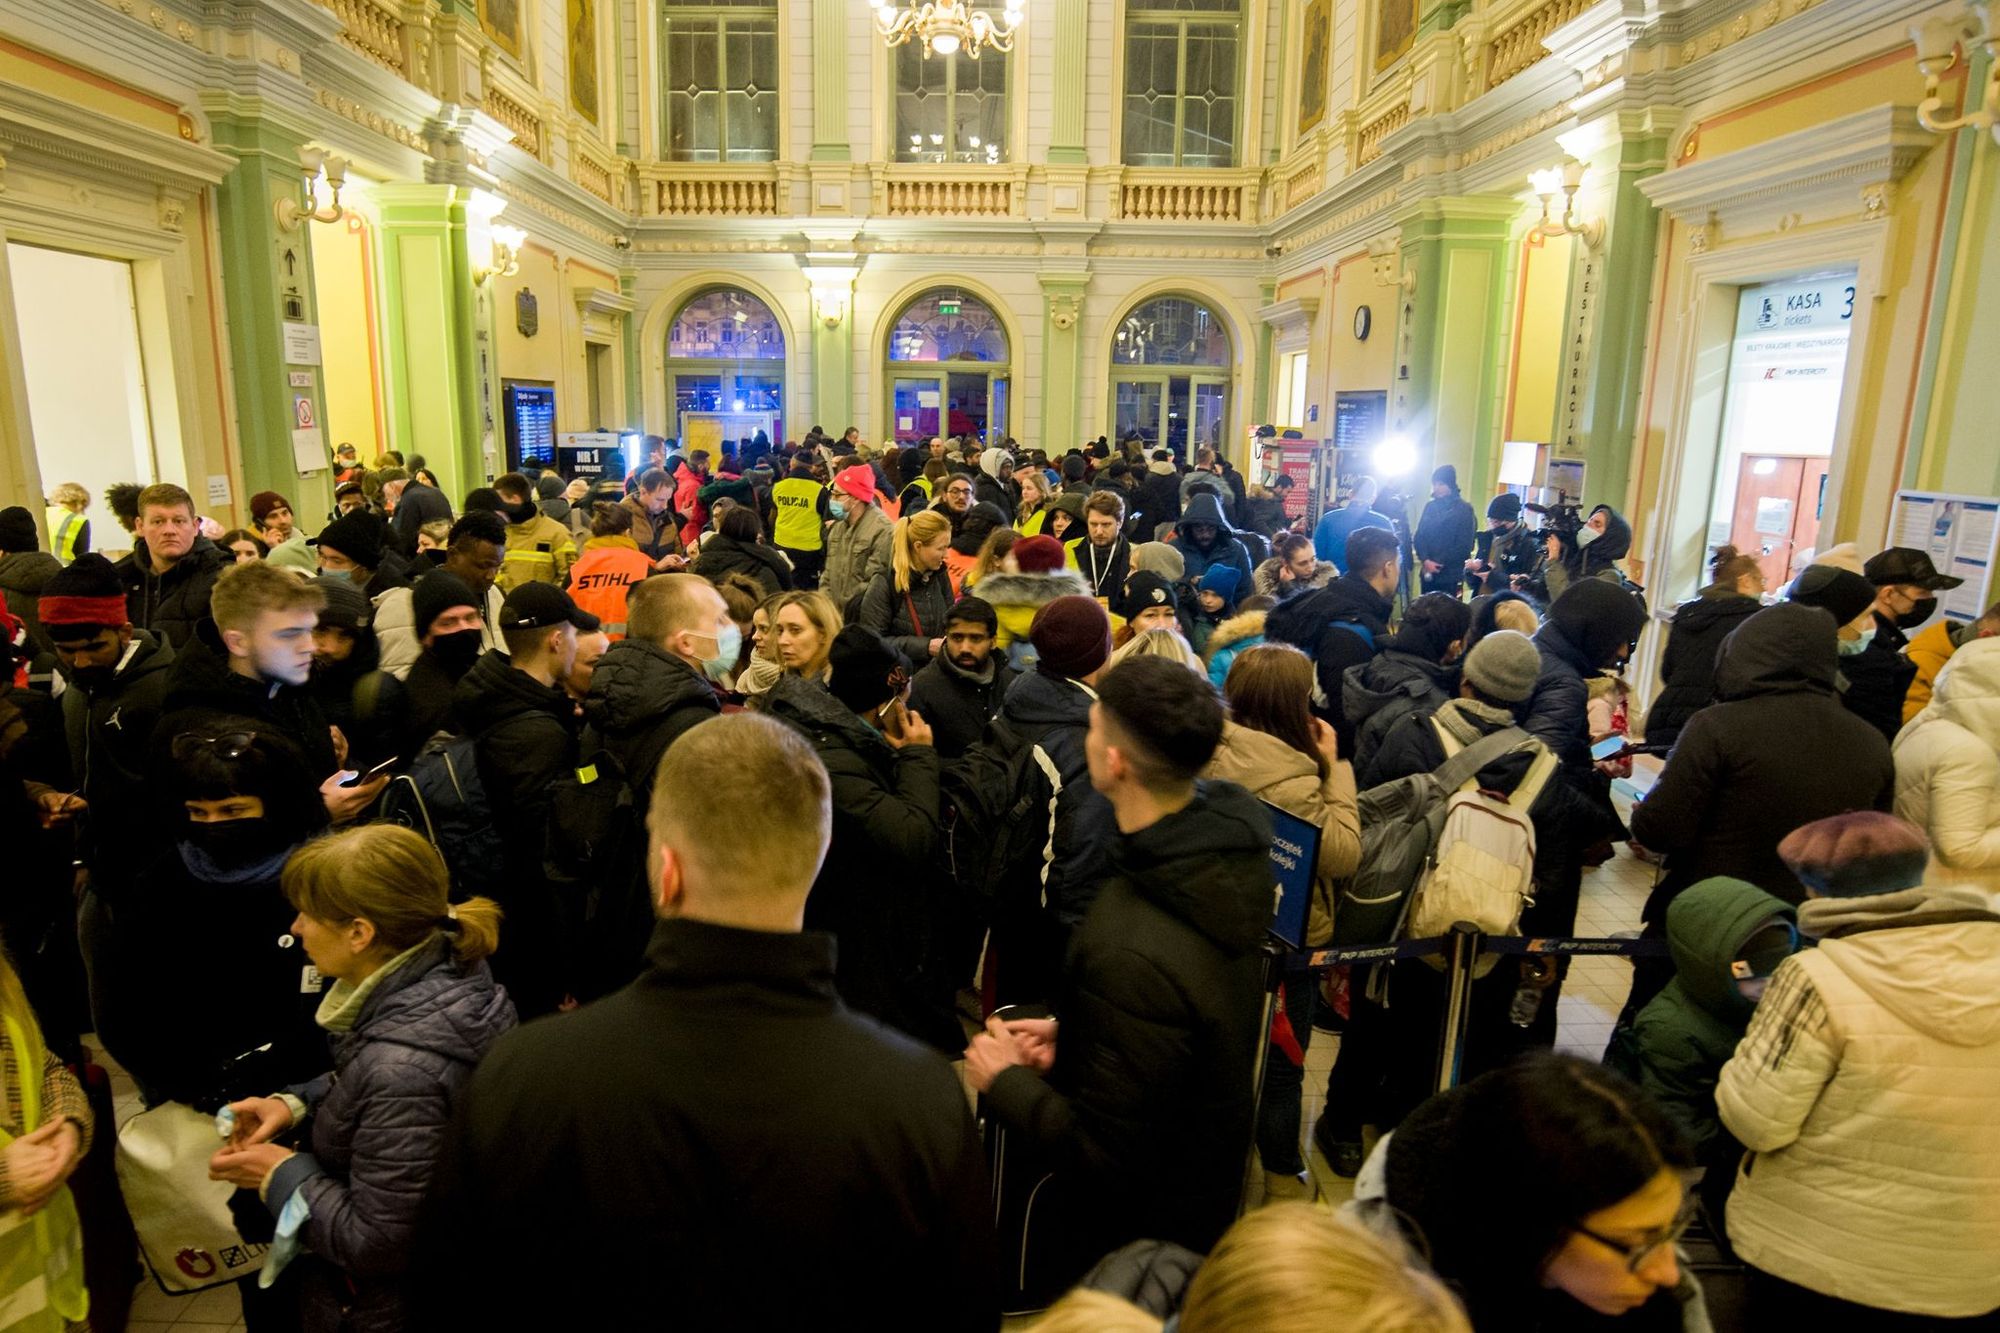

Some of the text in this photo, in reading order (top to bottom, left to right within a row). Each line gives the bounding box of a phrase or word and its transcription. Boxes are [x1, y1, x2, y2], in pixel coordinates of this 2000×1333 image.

[1786, 286, 1856, 319] KASA 3
[1784, 314, 1812, 326] tickets
[1566, 264, 1592, 446] RESTAURACJA
[576, 449, 599, 463] NR 1
[777, 495, 809, 508] POLICJA
[577, 573, 631, 590] STIHL
[1271, 835, 1304, 858] oczątek
[1268, 848, 1297, 871] kolejki
[1339, 951, 1358, 961] PKP
[1357, 947, 1398, 958] INTERCITY
[1577, 942, 1623, 951] INTERCITY
